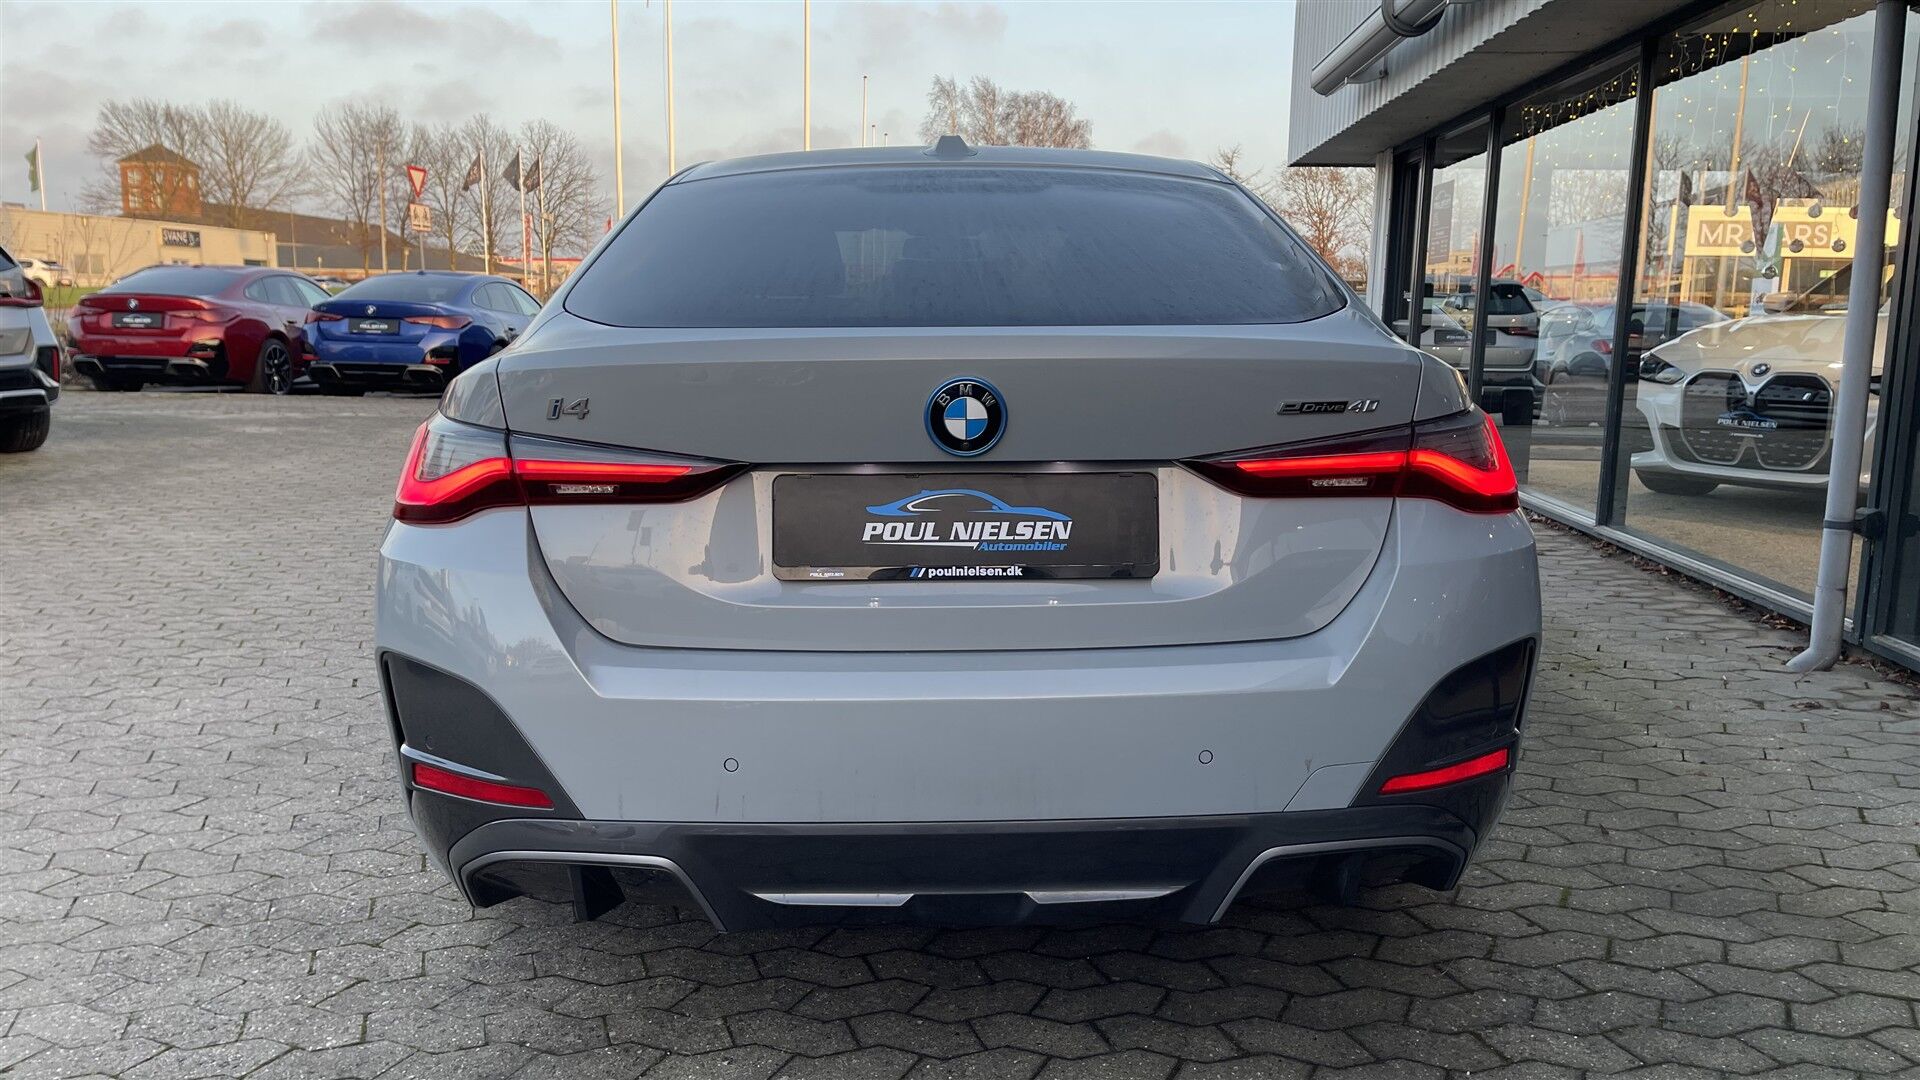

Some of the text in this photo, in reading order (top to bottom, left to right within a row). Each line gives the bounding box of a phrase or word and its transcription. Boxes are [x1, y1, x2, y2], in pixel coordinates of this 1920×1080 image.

[1700, 223, 1829, 246] MR ARS
[937, 383, 997, 408] BMW
[546, 397, 590, 420] i4
[861, 521, 1073, 542] POUL NIELSEN
[978, 541, 1068, 552] Automobiler
[928, 566, 1023, 578] poulnielsen.dk
